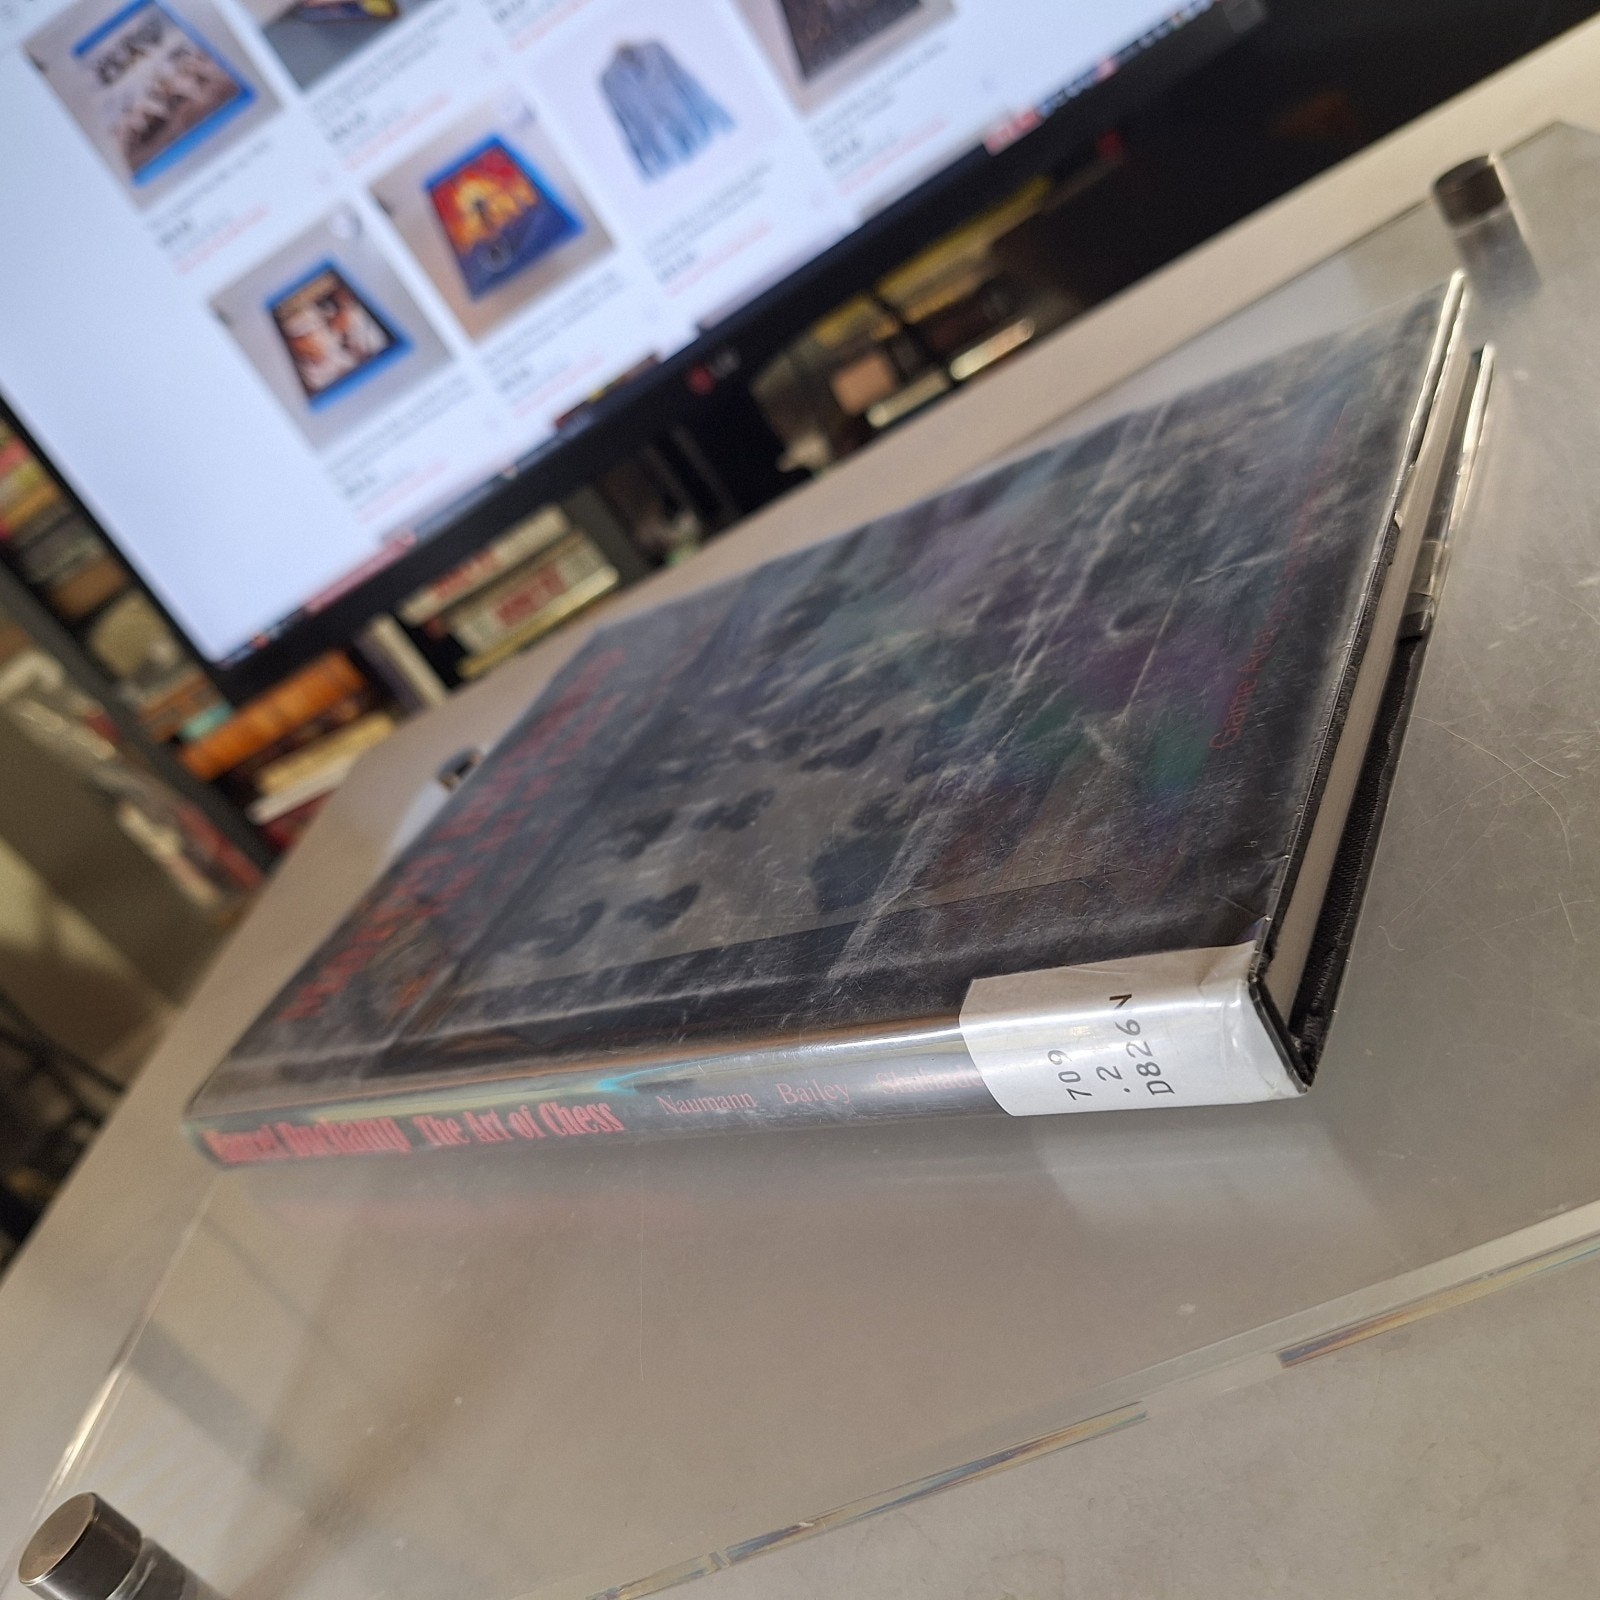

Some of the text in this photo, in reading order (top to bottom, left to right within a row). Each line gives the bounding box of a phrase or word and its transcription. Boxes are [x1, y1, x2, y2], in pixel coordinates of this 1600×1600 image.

[1047, 1049, 1093, 1101] 709
[1095, 1065, 1131, 1093] .2
[656, 1091, 758, 1115] Naumann
[775, 1079, 852, 1105] Bailey
[413, 1114, 470, 1146] The
[463, 1109, 512, 1142] Art
[508, 1106, 546, 1139] of
[538, 1100, 625, 1136] Chess
